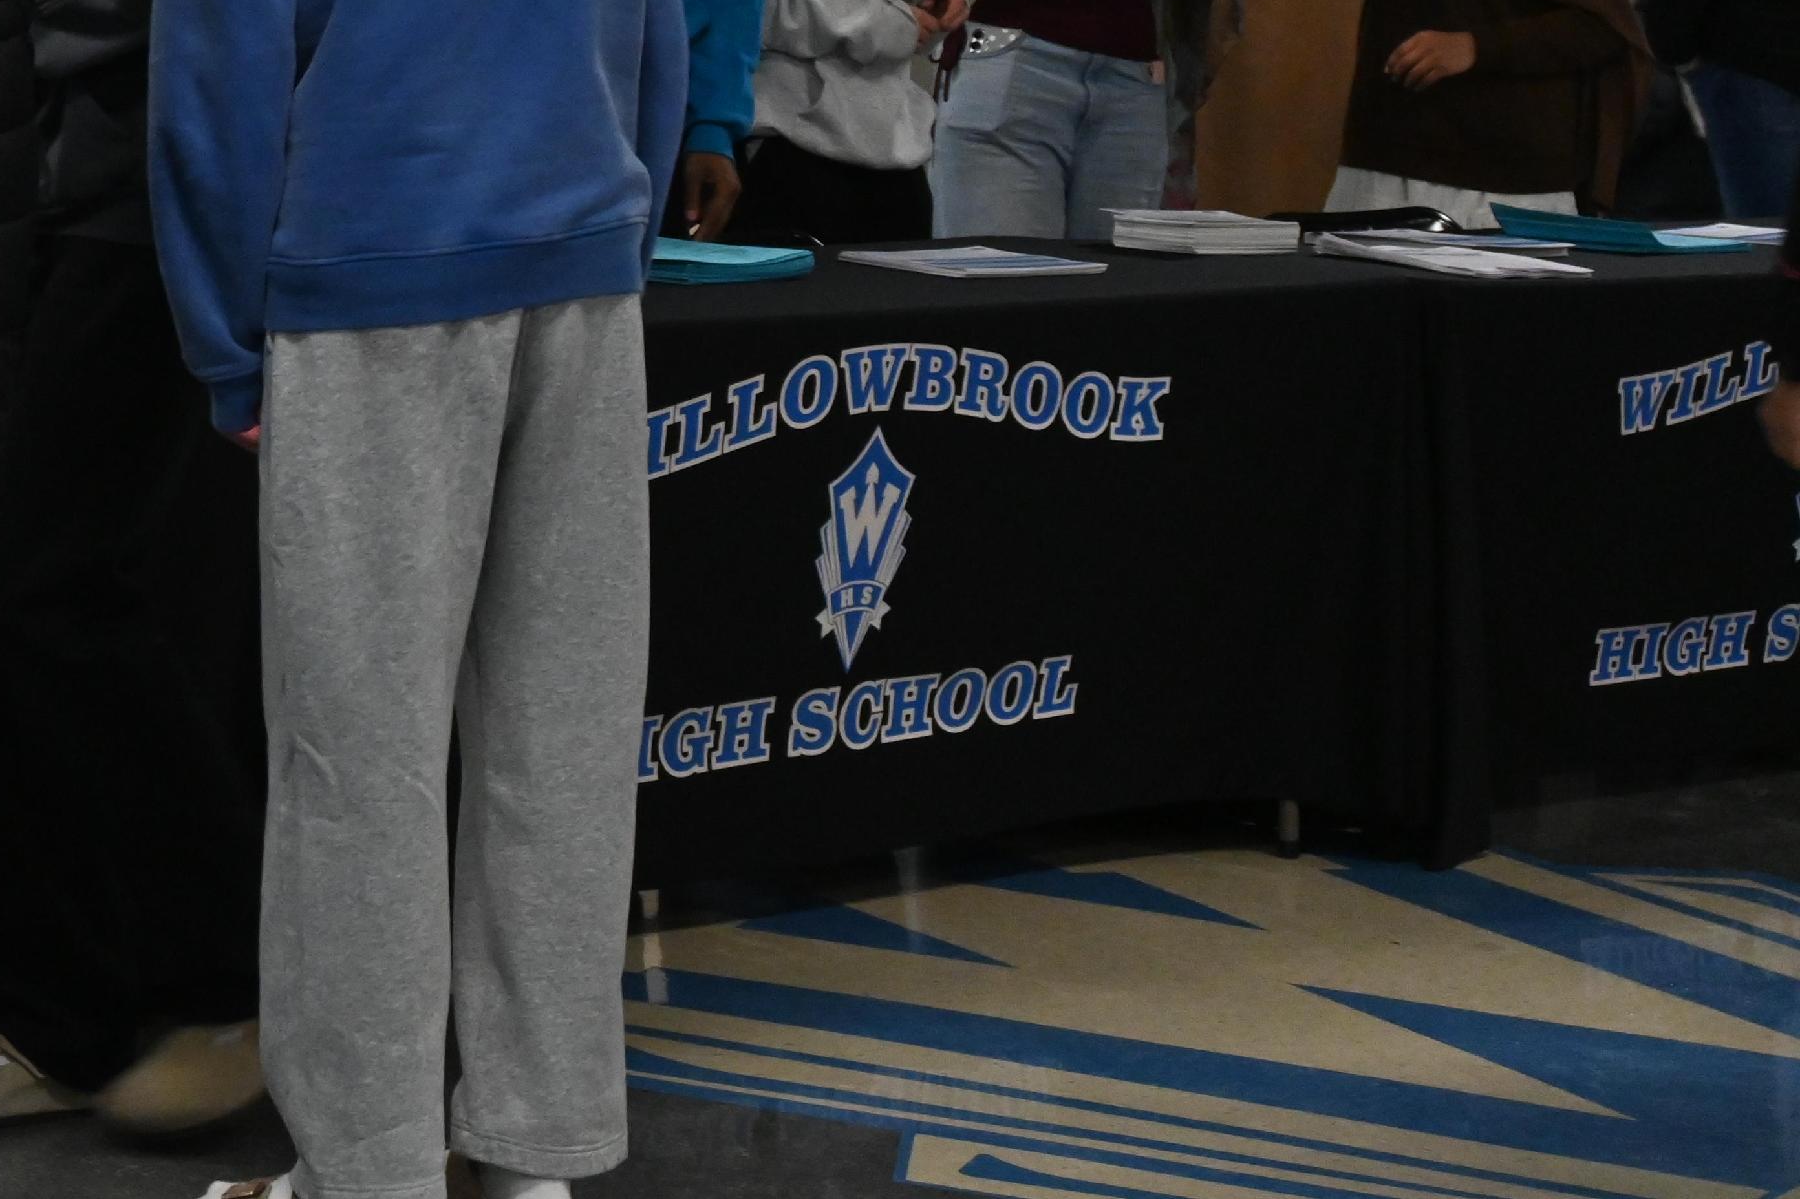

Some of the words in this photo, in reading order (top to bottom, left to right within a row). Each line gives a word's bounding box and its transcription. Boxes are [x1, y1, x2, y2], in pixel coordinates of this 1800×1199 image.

[646, 342, 1171, 480] ILLOWBROOK
[1589, 610, 1757, 686] HIGH
[637, 696, 776, 783] IGH
[788, 654, 1079, 758] SCHOOL
